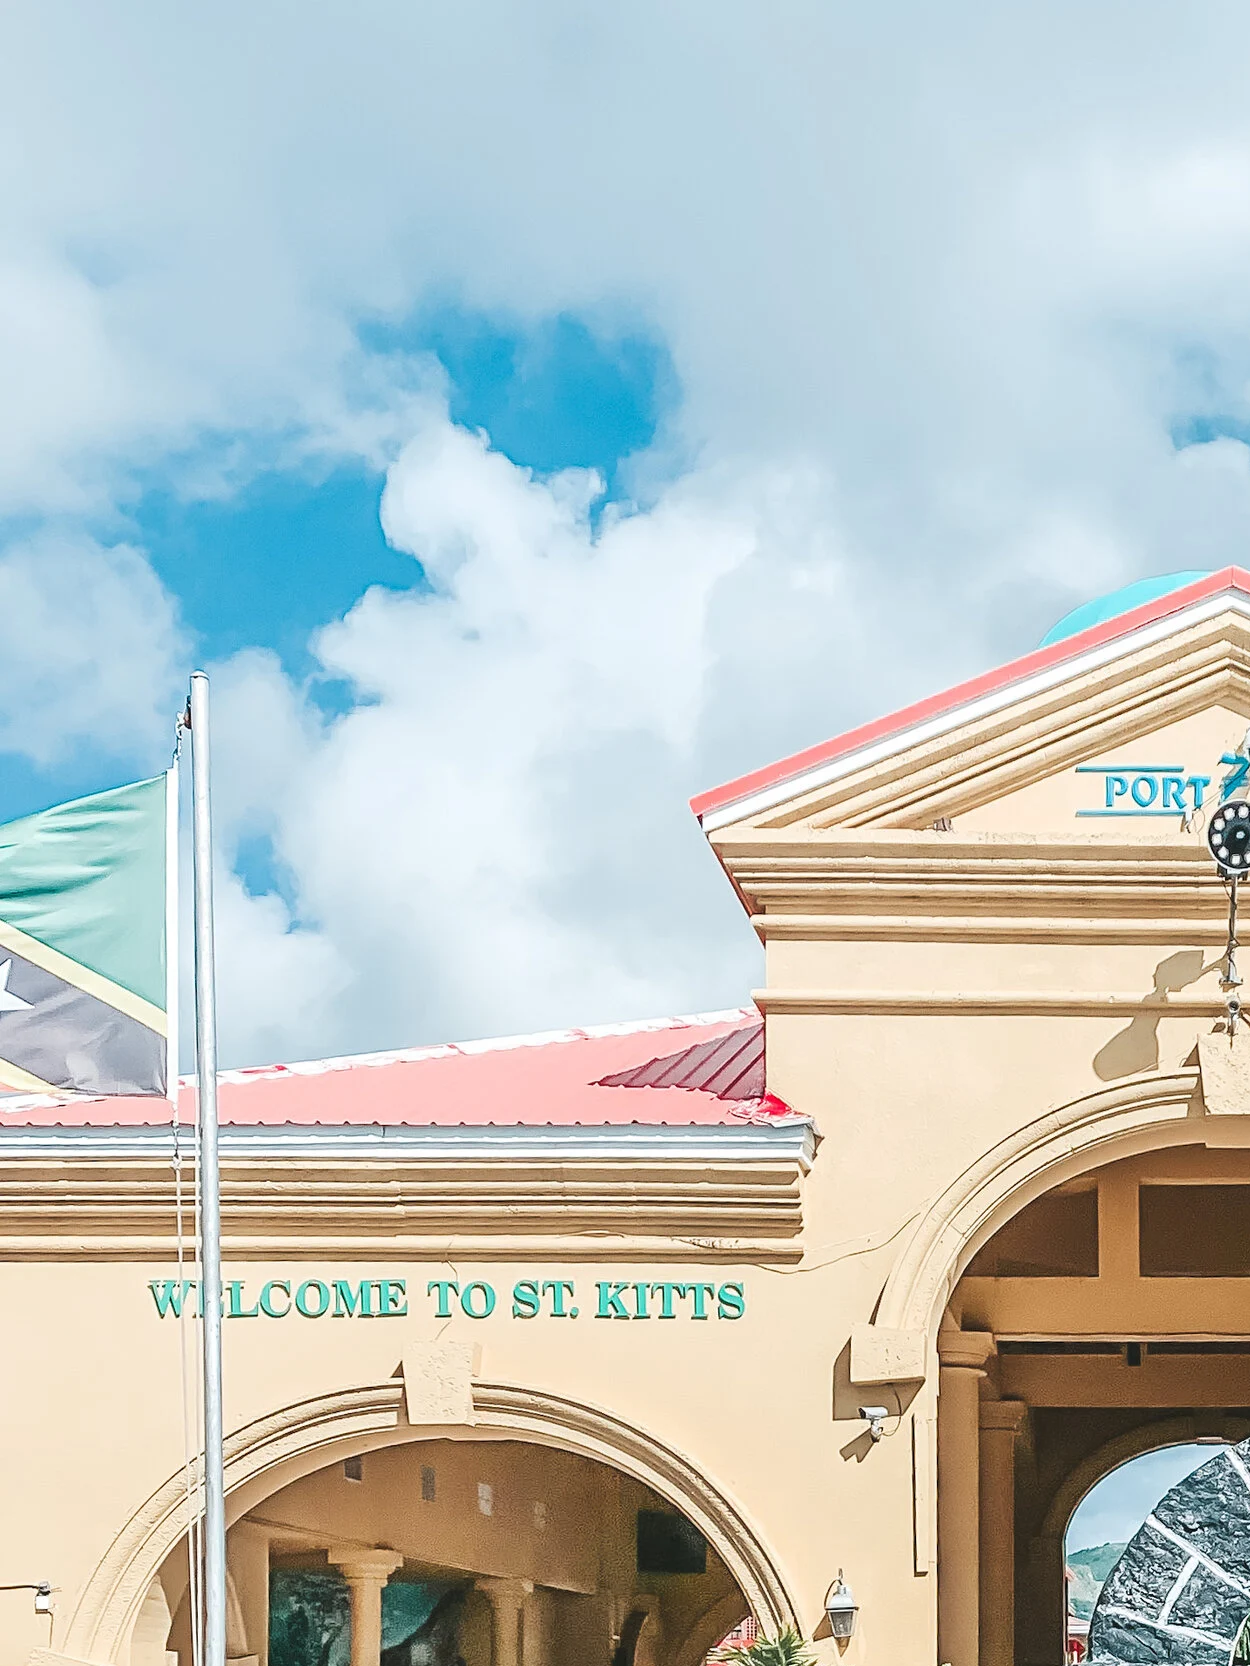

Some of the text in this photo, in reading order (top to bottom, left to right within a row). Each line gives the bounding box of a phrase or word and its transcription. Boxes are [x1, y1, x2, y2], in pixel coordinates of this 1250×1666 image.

[1105, 774, 1211, 808] PORT
[428, 1281, 497, 1319] TO
[512, 1281, 580, 1319] ST.
[596, 1282, 746, 1320] KITTS
